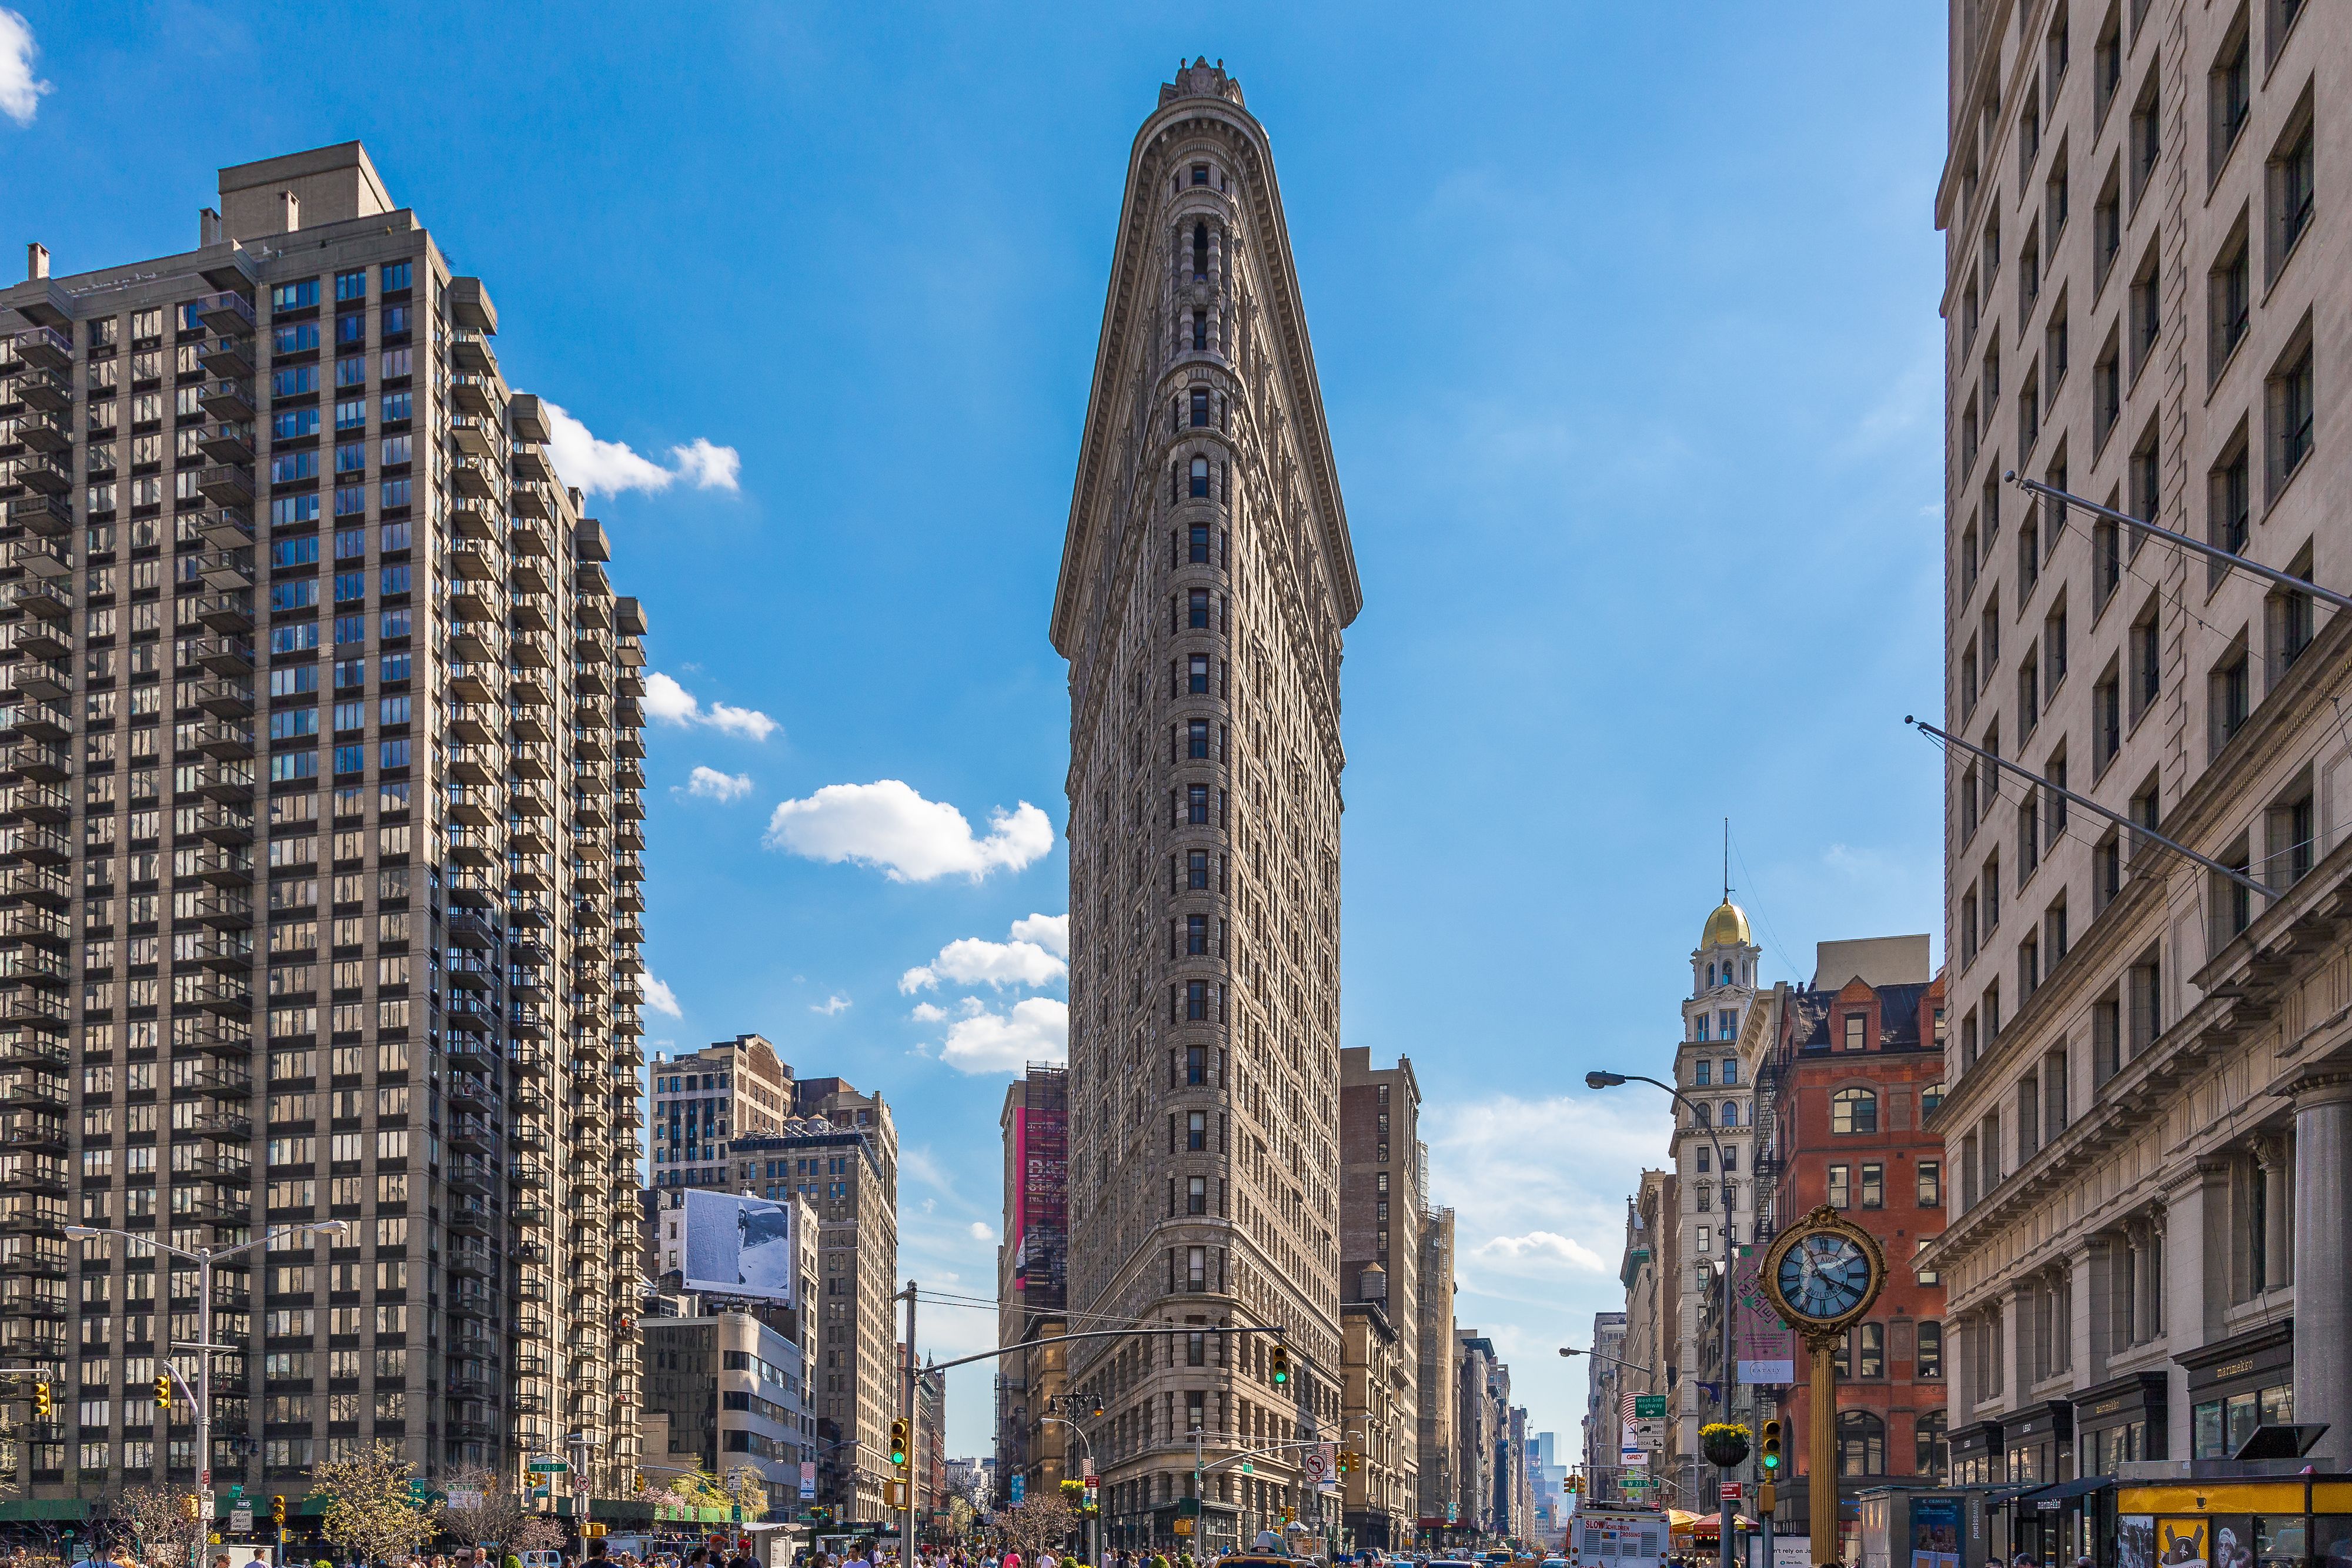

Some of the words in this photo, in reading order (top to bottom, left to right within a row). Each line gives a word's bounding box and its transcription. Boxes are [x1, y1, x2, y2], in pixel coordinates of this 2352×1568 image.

[1806, 1285, 1842, 1298] BUILDING
[2217, 1360, 2253, 1378] marimekko
[2096, 1400, 2119, 1413] marimekko
[2023, 1423, 2031, 1433] LEGO
[2037, 1499, 2061, 1509] marimekko
